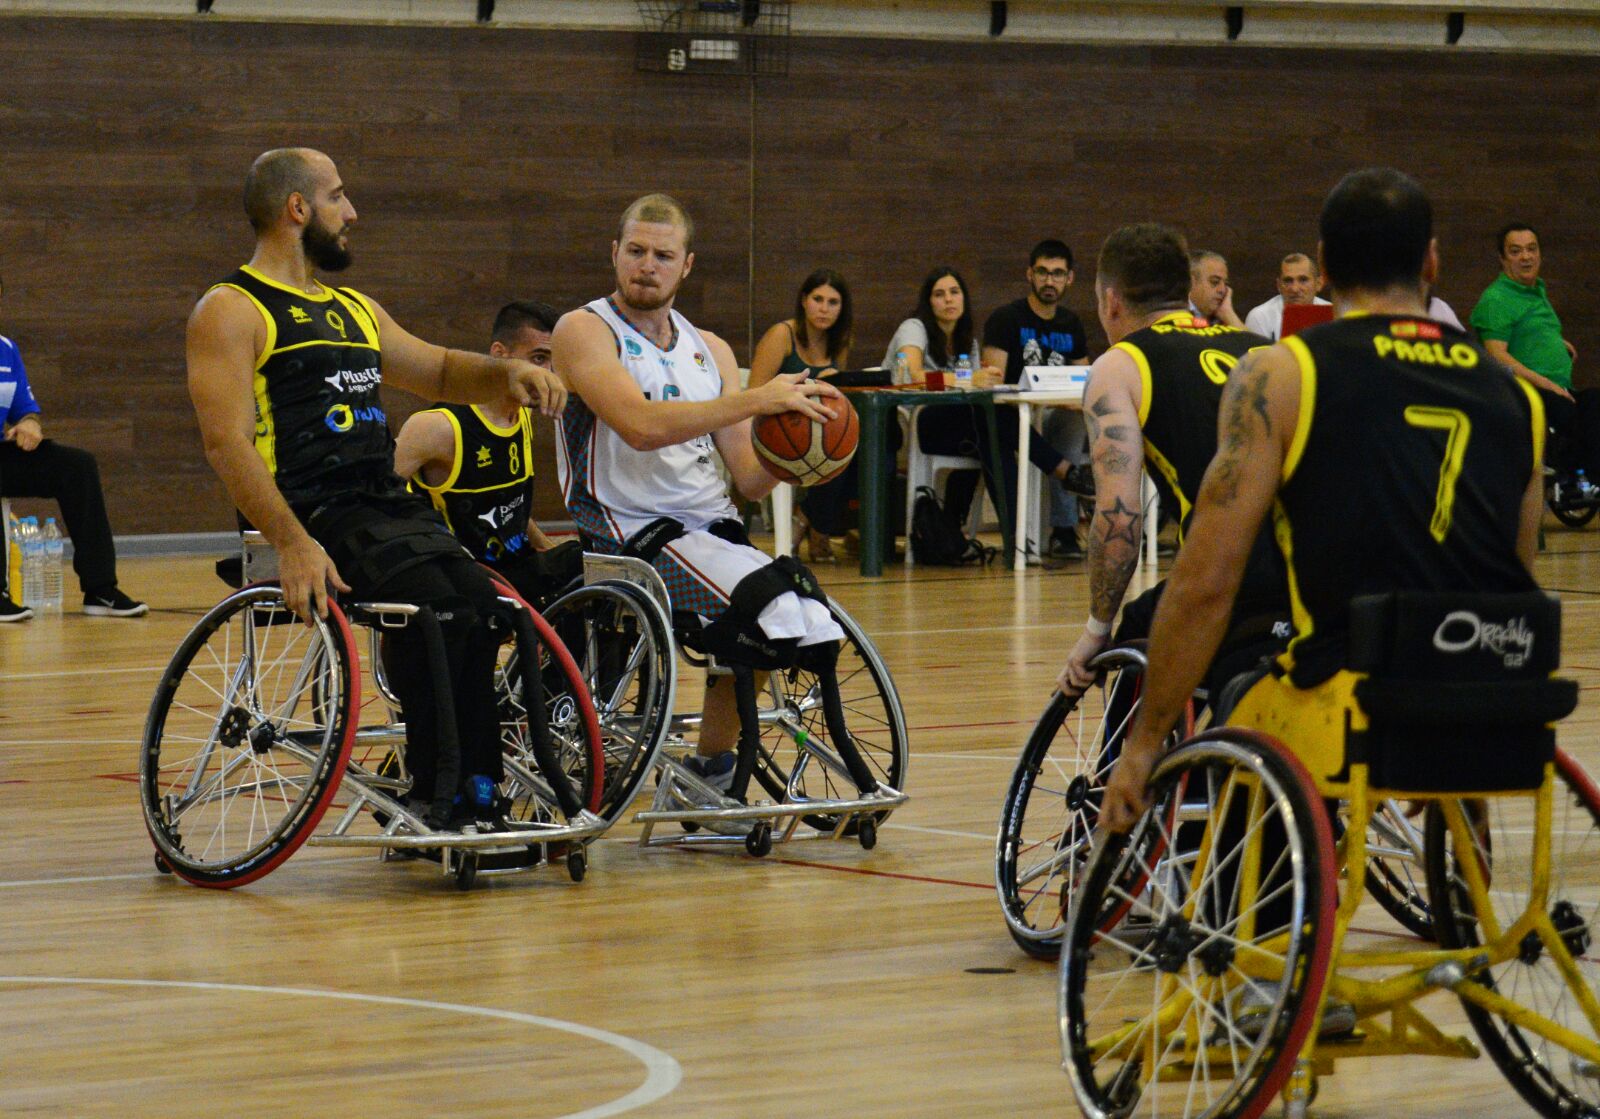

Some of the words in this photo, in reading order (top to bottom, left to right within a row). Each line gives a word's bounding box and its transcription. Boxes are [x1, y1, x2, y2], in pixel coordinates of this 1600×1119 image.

[324, 309, 348, 339] 9
[1373, 334, 1479, 368] PABLO
[508, 441, 520, 475] 8
[1403, 405, 1471, 543] 7
